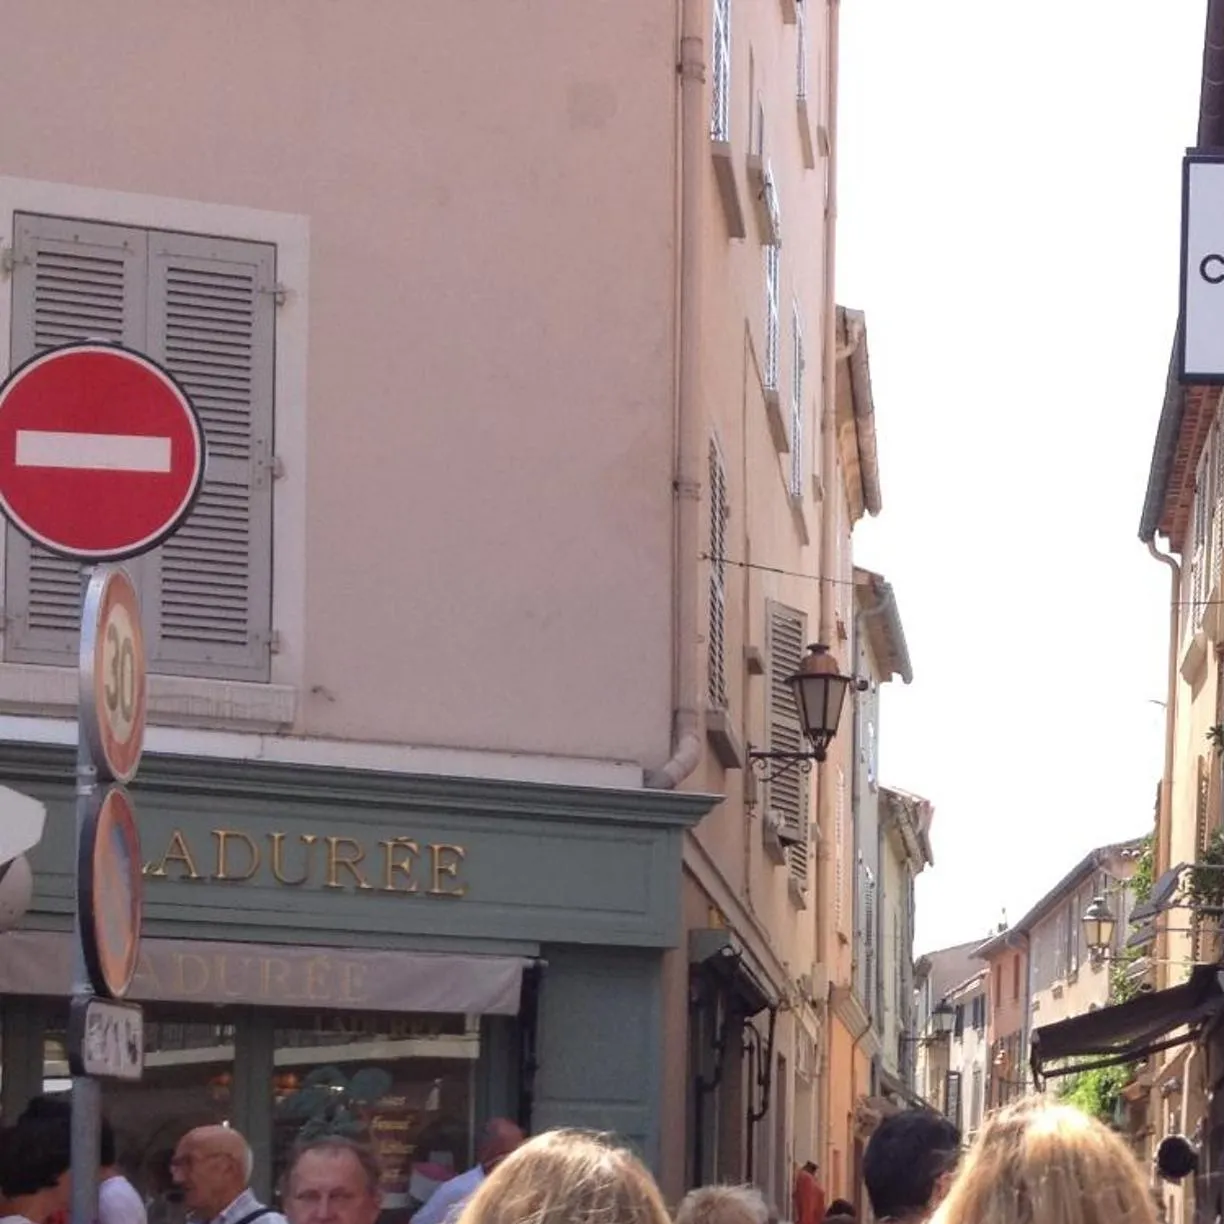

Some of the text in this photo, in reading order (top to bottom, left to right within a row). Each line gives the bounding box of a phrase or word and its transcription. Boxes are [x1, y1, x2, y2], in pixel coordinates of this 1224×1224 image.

[104, 622, 134, 723] 30
[141, 828, 468, 897] ADURÉE
[136, 952, 369, 1001] ADURÉE
